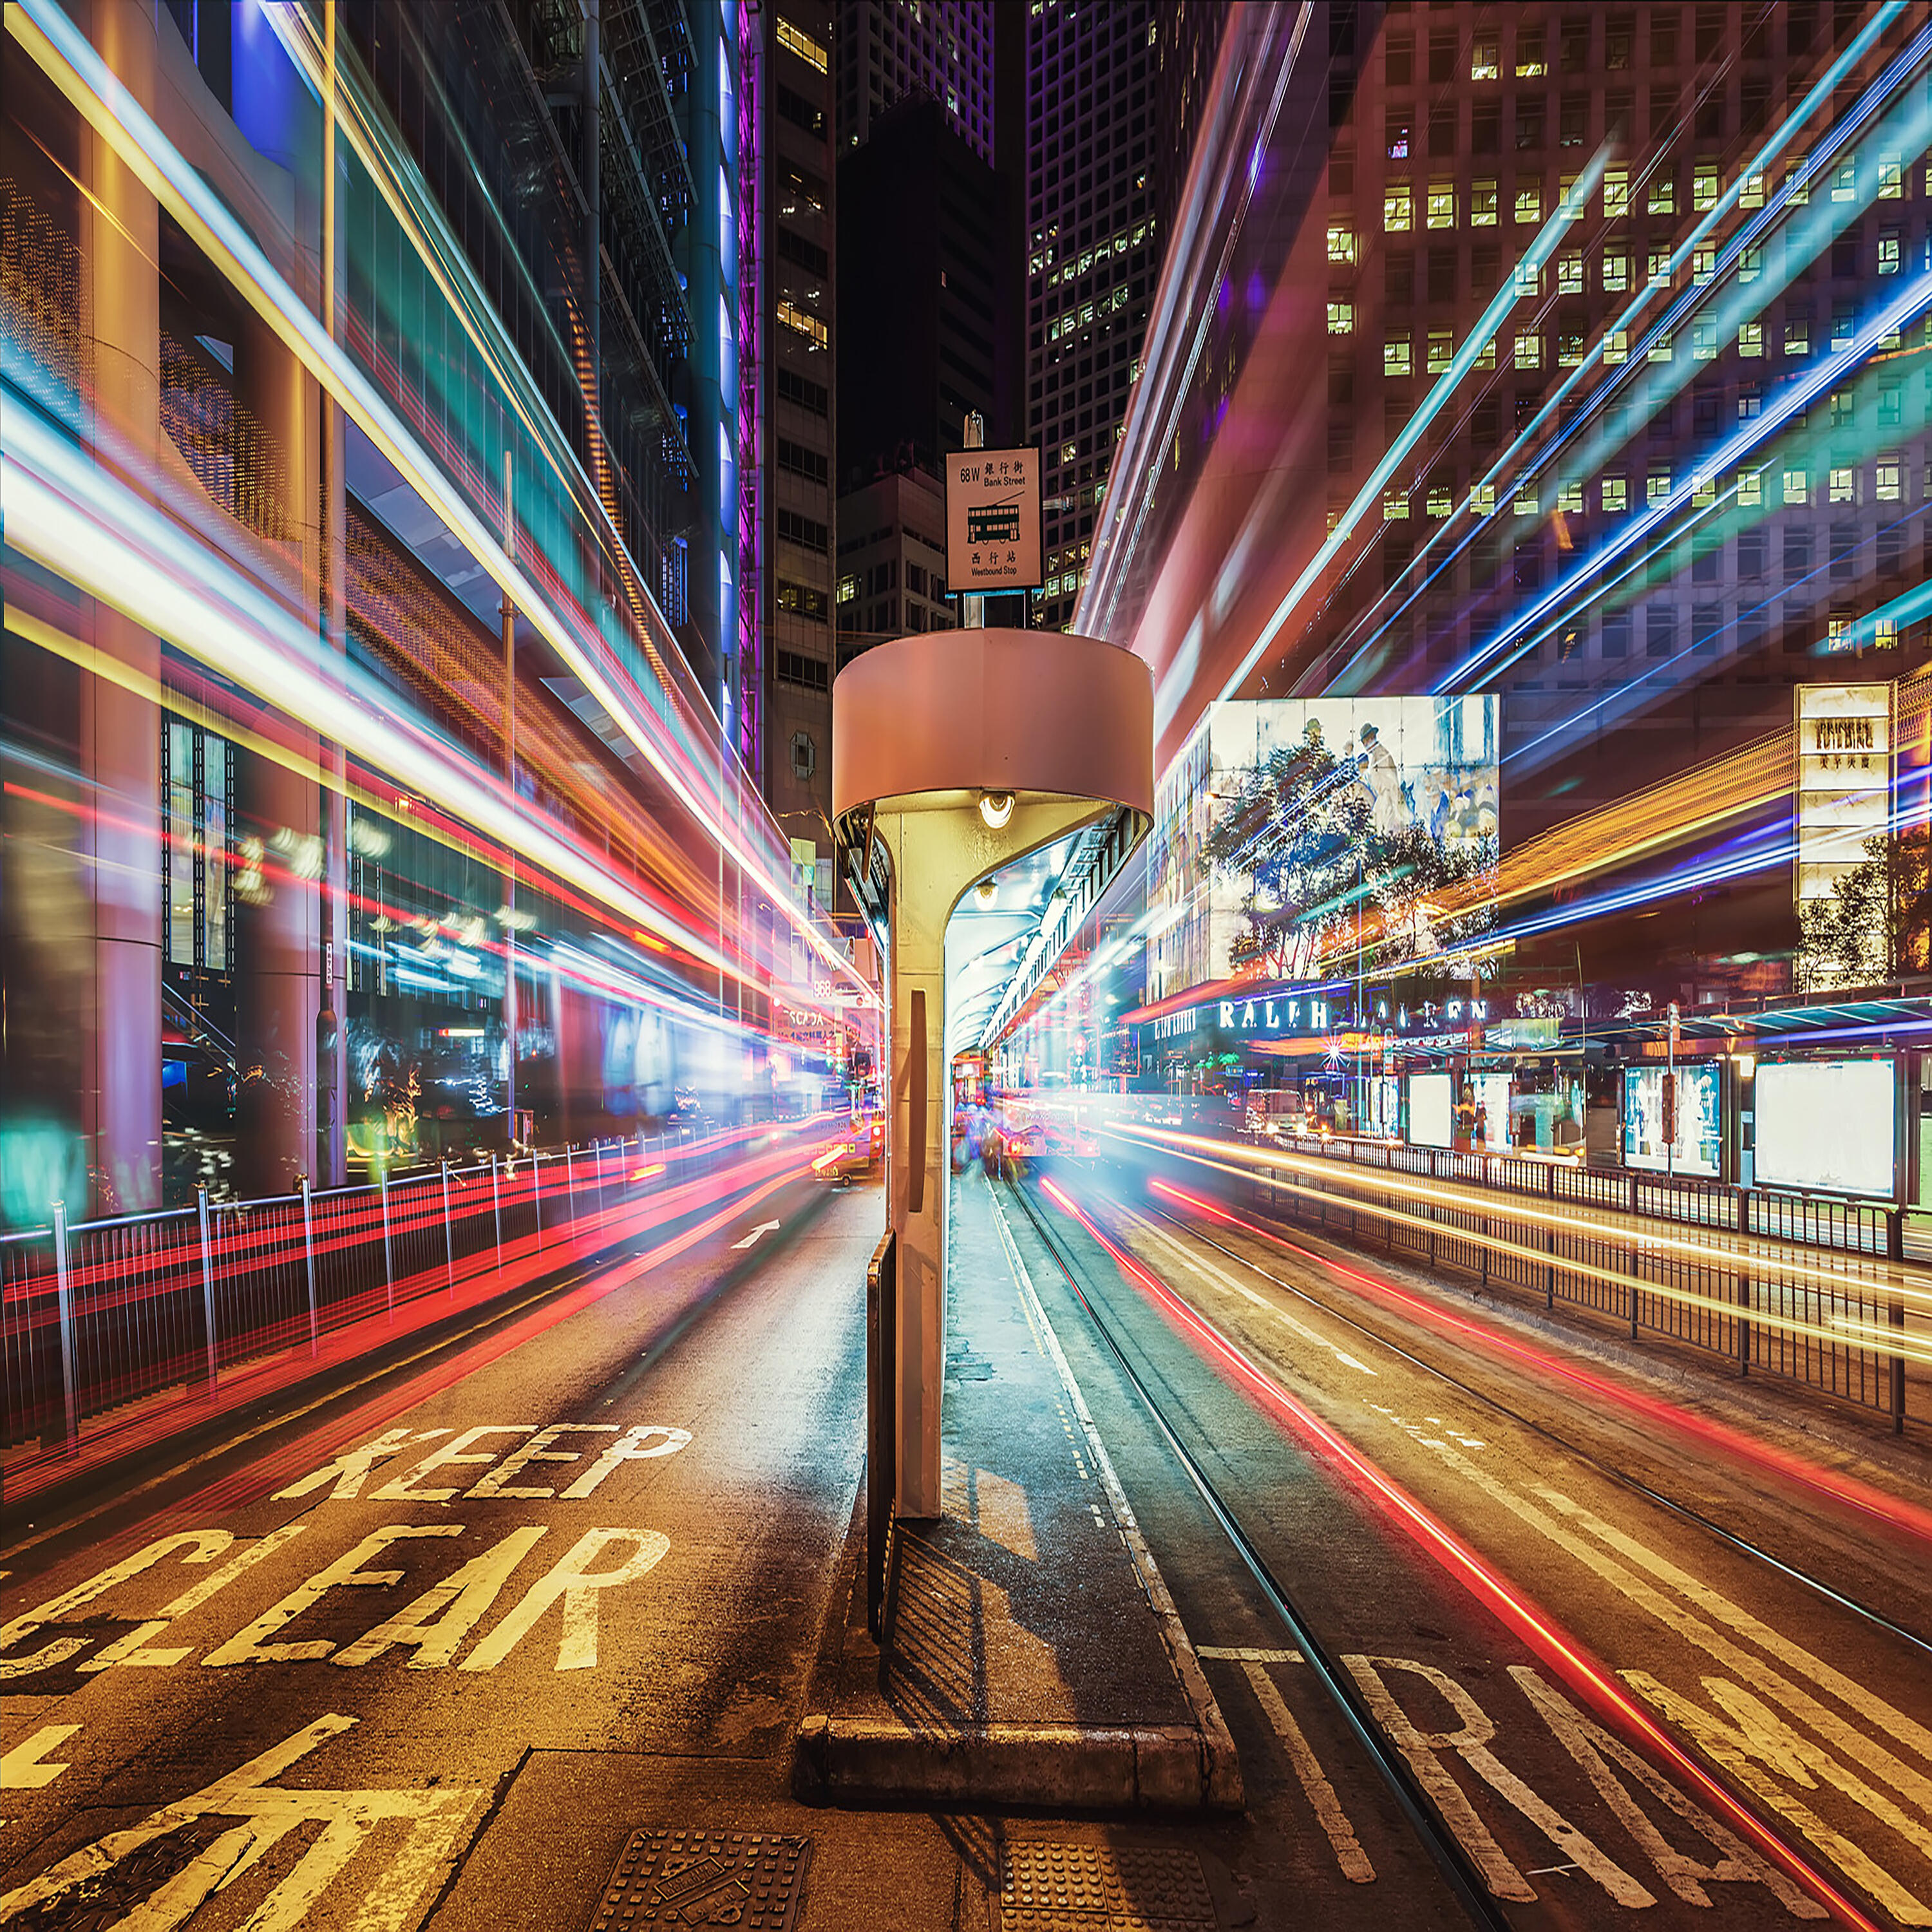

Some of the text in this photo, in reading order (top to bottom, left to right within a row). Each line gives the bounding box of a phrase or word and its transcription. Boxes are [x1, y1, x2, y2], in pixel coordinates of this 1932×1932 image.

[960, 468, 980, 483] 68W
[985, 460, 1023, 475] 銀行街
[984, 476, 1025, 487] Bank Street
[971, 551, 1016, 565] 西行站
[971, 565, 1017, 576] Westbound Stop
[813, 980, 831, 998] 968
[1219, 1000, 1327, 1028] RALPH
[269, 1423, 694, 1501] KEEP
[0, 1524, 672, 1676] CLEAR
[1197, 1644, 1932, 1929] TRAM
